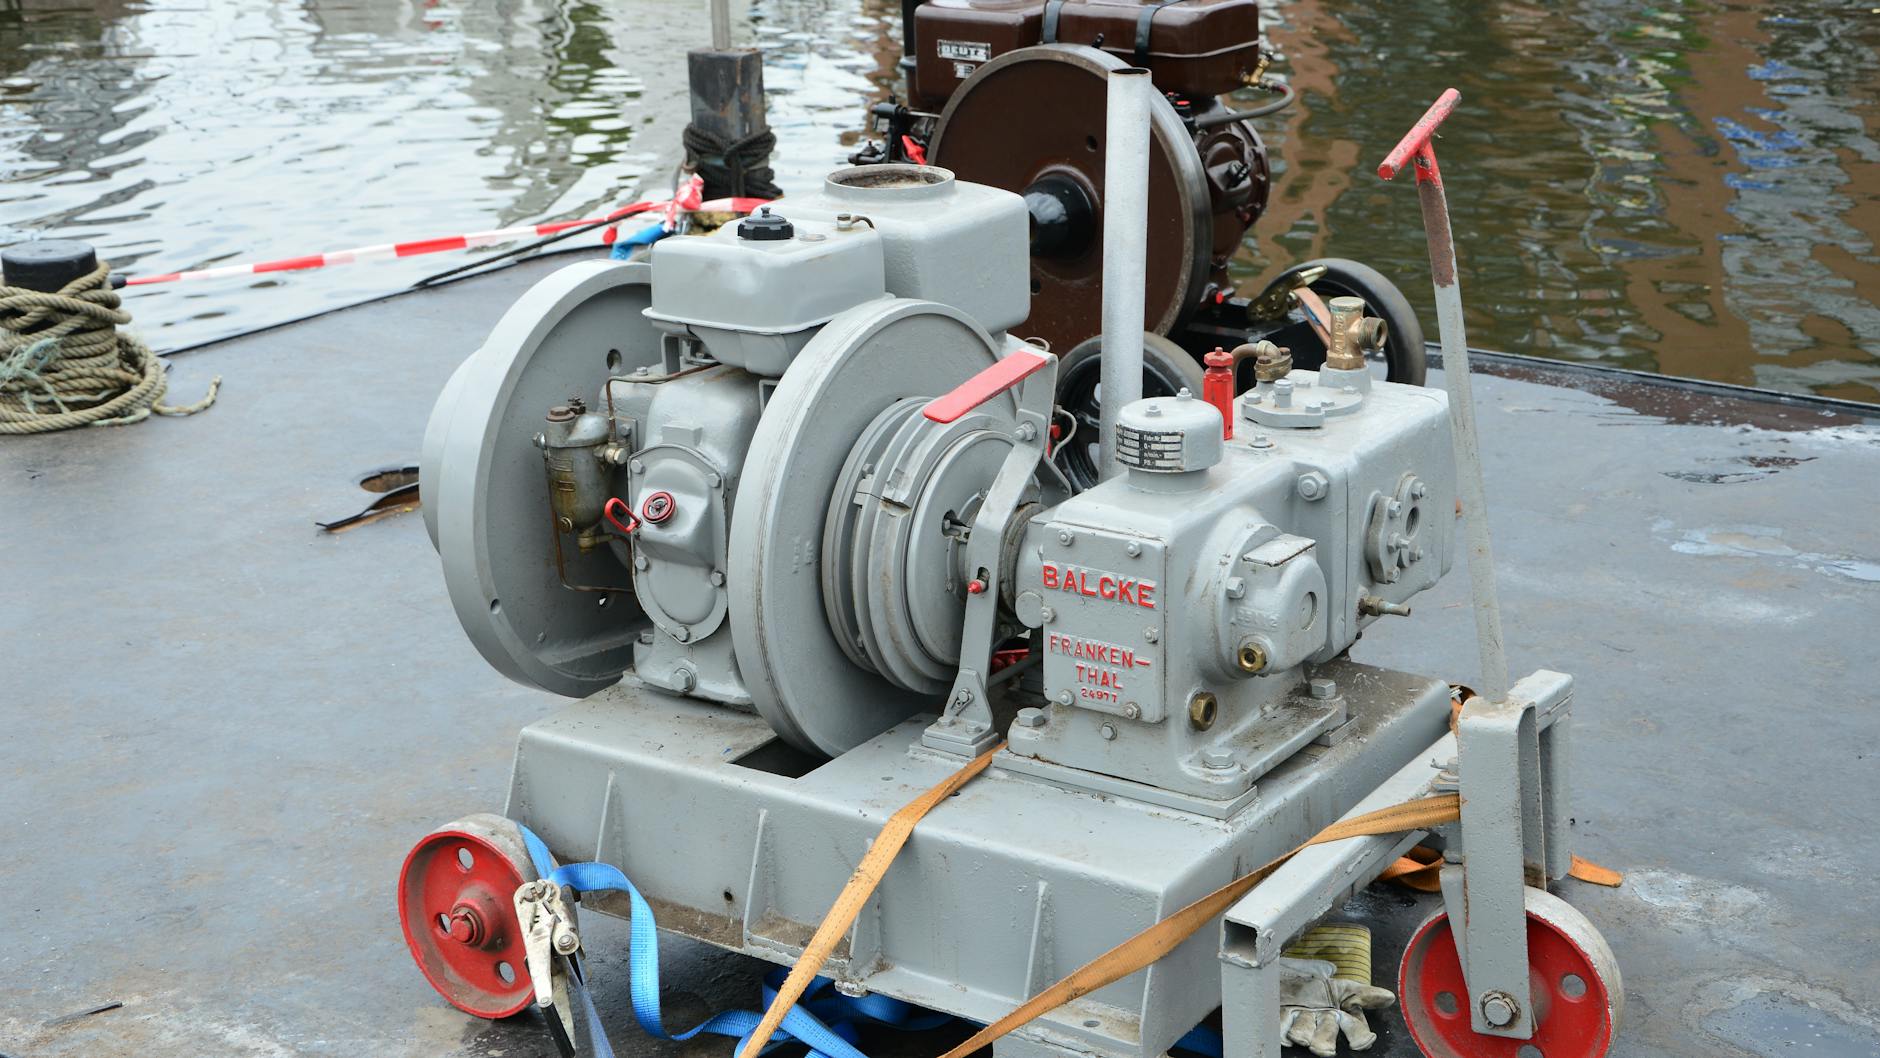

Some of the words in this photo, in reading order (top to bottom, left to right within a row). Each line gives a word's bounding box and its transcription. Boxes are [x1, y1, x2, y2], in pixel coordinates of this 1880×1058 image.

[941, 45, 987, 57] DEUTZ
[1042, 563, 1157, 609] BALCKE
[1075, 663, 1124, 690] THAL
[1080, 687, 1119, 703] 24977
